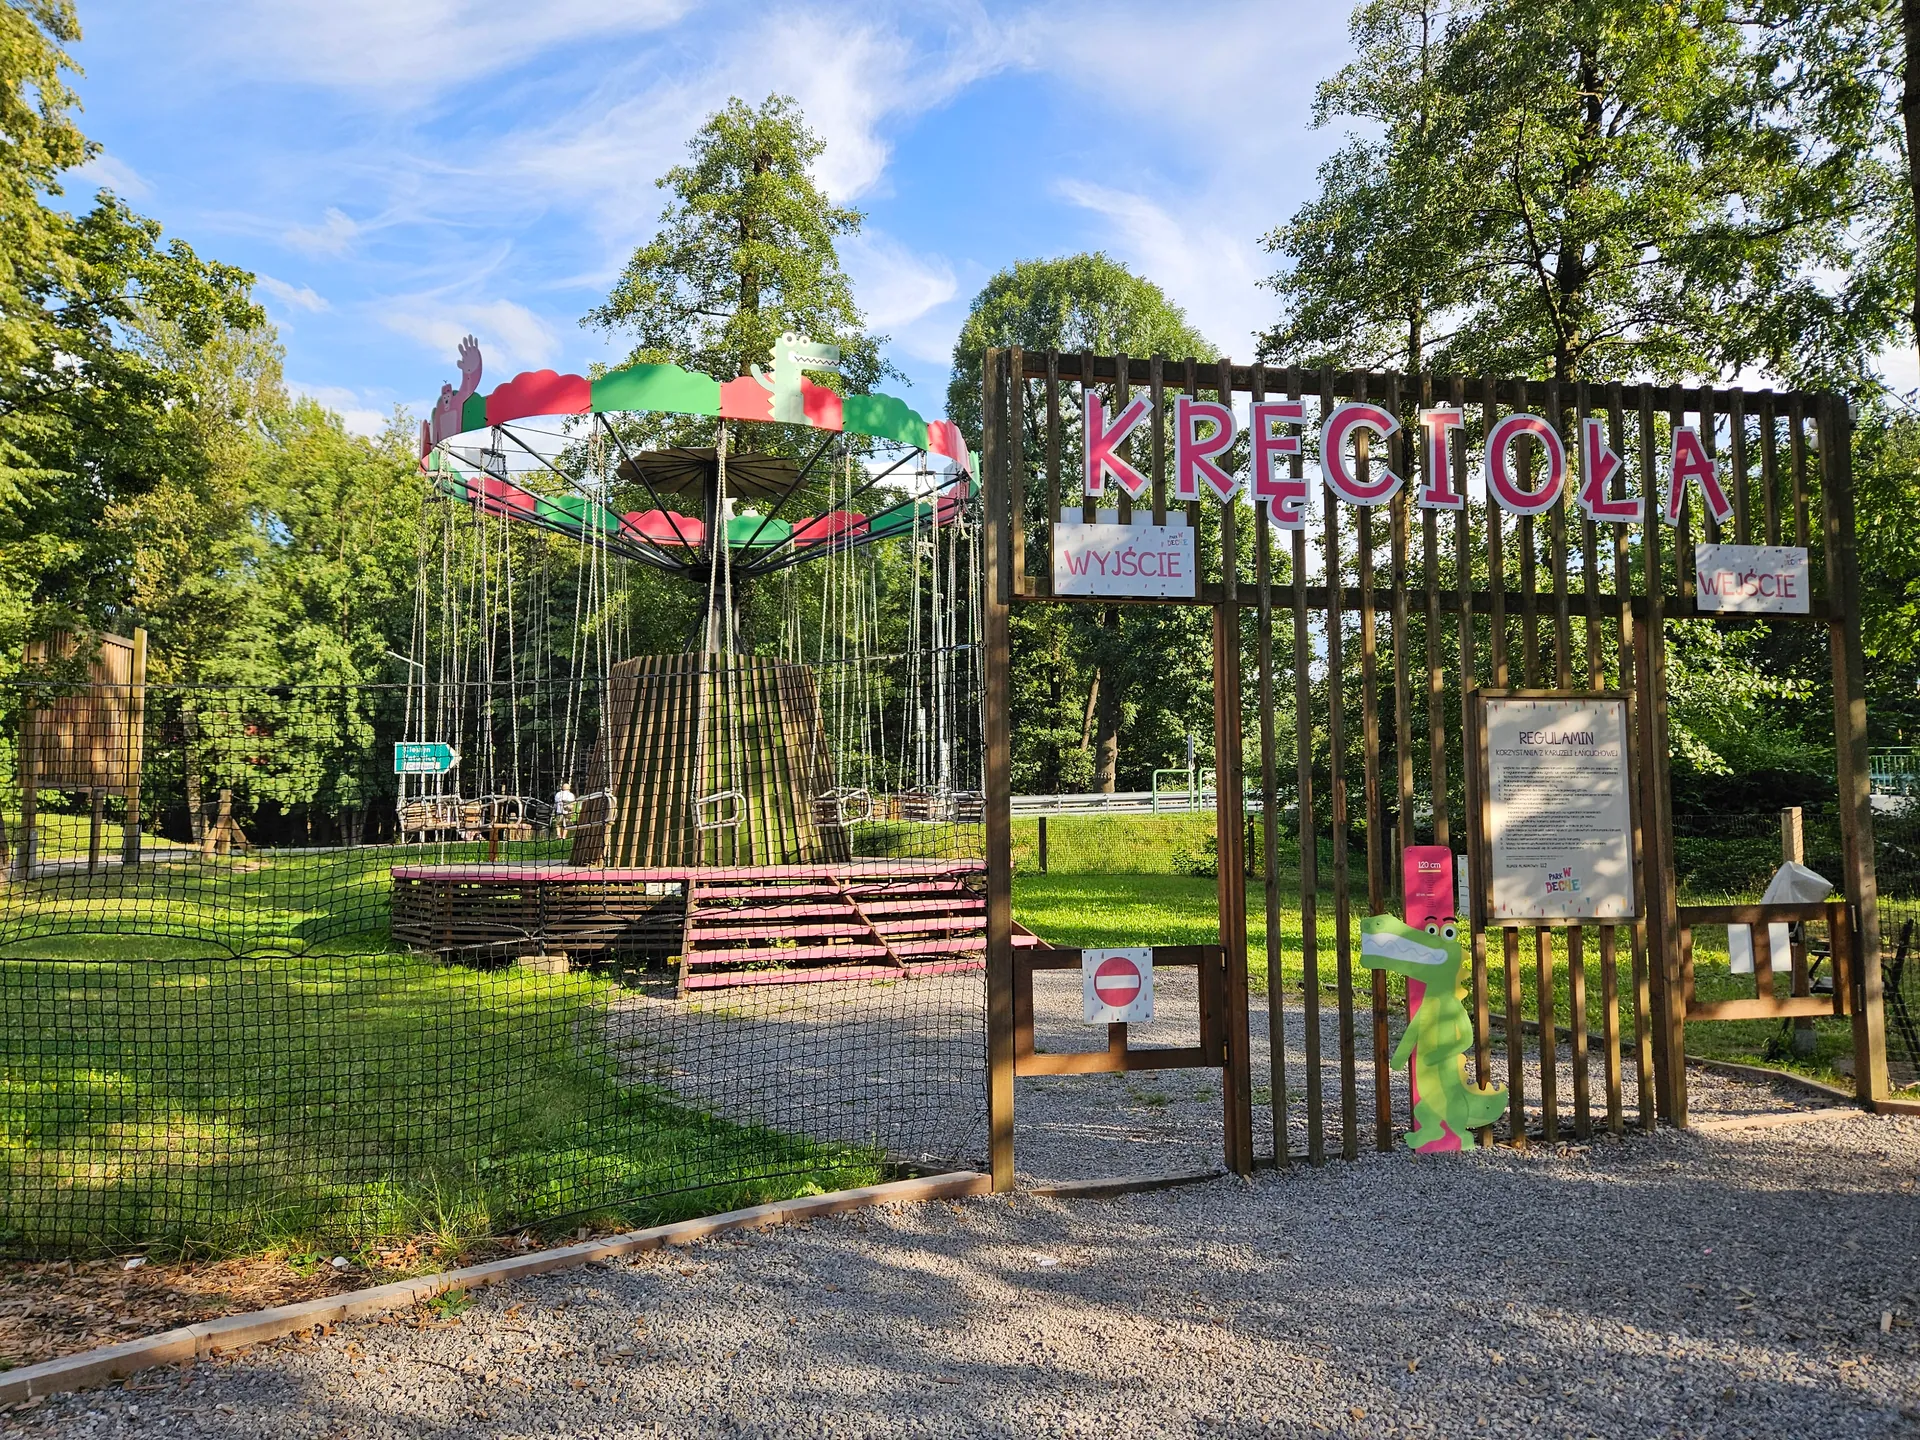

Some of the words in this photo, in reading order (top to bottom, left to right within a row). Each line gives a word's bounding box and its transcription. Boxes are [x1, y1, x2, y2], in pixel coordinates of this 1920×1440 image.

[1085, 390, 1733, 530] KRĘCIOŁA
[1064, 547, 1182, 577] WYJŚCIE
[1698, 568, 1796, 598] WEJŚCIE
[1519, 731, 1594, 745] REGULAMIN
[1496, 749, 1538, 757] KORZYSTANIA
[1539, 749, 1544, 757] Z
[1545, 749, 1573, 757] KARUZELI
[1574, 748, 1618, 757] ŁAŃCUCHOWEJ
[1563, 867, 1572, 877] W
